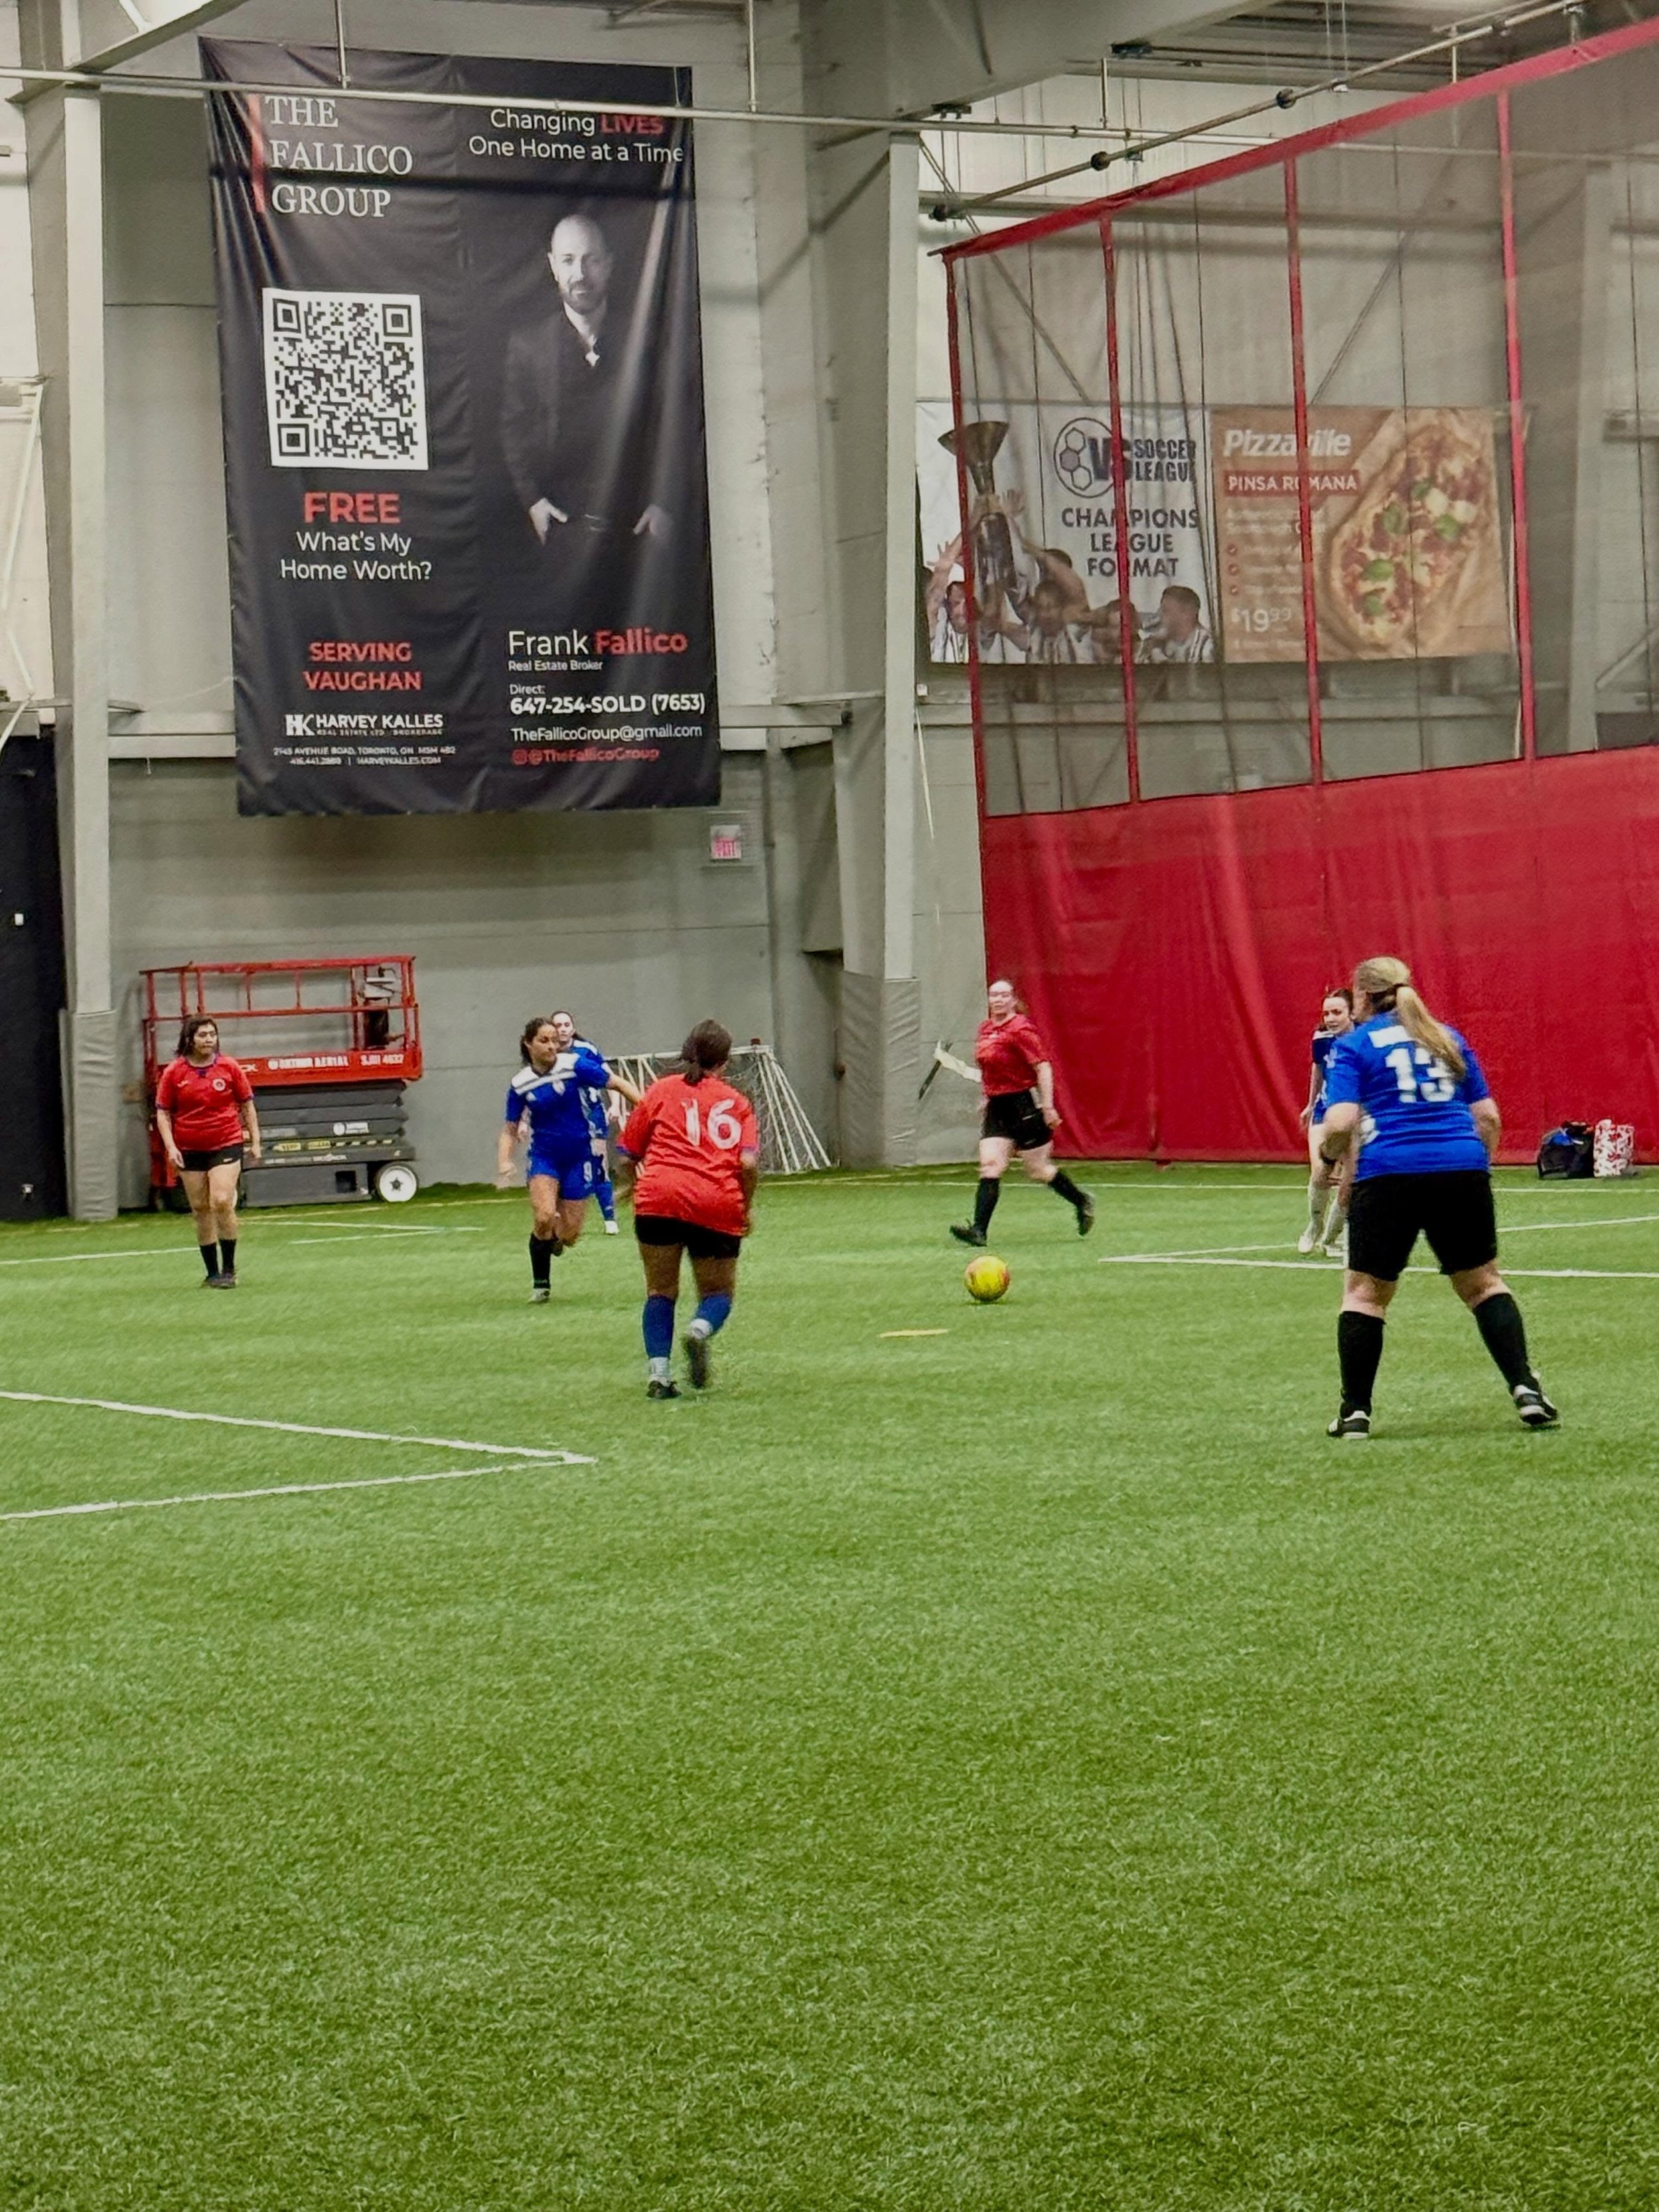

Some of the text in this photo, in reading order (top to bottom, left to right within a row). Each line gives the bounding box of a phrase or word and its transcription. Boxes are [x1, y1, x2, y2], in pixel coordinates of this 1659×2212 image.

[265, 95, 338, 127] THE
[490, 109, 664, 136] Changing LIVES
[269, 139, 413, 175] FALLICO
[469, 136, 684, 163] One Home at a Time
[271, 184, 391, 218] GROUP
[1222, 429, 1352, 457] Pizzaille
[1228, 475, 1278, 491] PINSA
[303, 492, 401, 524] FREE
[1062, 507, 1200, 529] CHAPIONS
[296, 530, 411, 557] What's My
[1090, 533, 1173, 553] LEGUE
[281, 559, 432, 580] Home Worth?
[1087, 557, 1179, 577] FOMAT
[309, 642, 412, 662] SERVING
[508, 627, 689, 655] Frank Fallico
[508, 660, 603, 671] Real Estate Broker
[303, 671, 422, 691] VAUGHAN
[509, 684, 545, 694] Direct:
[510, 693, 705, 715] 647-254-SOLD (7653)
[316, 713, 443, 729] HARVEY KALLES
[510, 724, 703, 742] TheFallicoGroup@gmail.com
[294, 747, 330, 755] AVENUE
[1385, 1047, 1456, 1104] 13
[682, 1098, 742, 1150] 16
